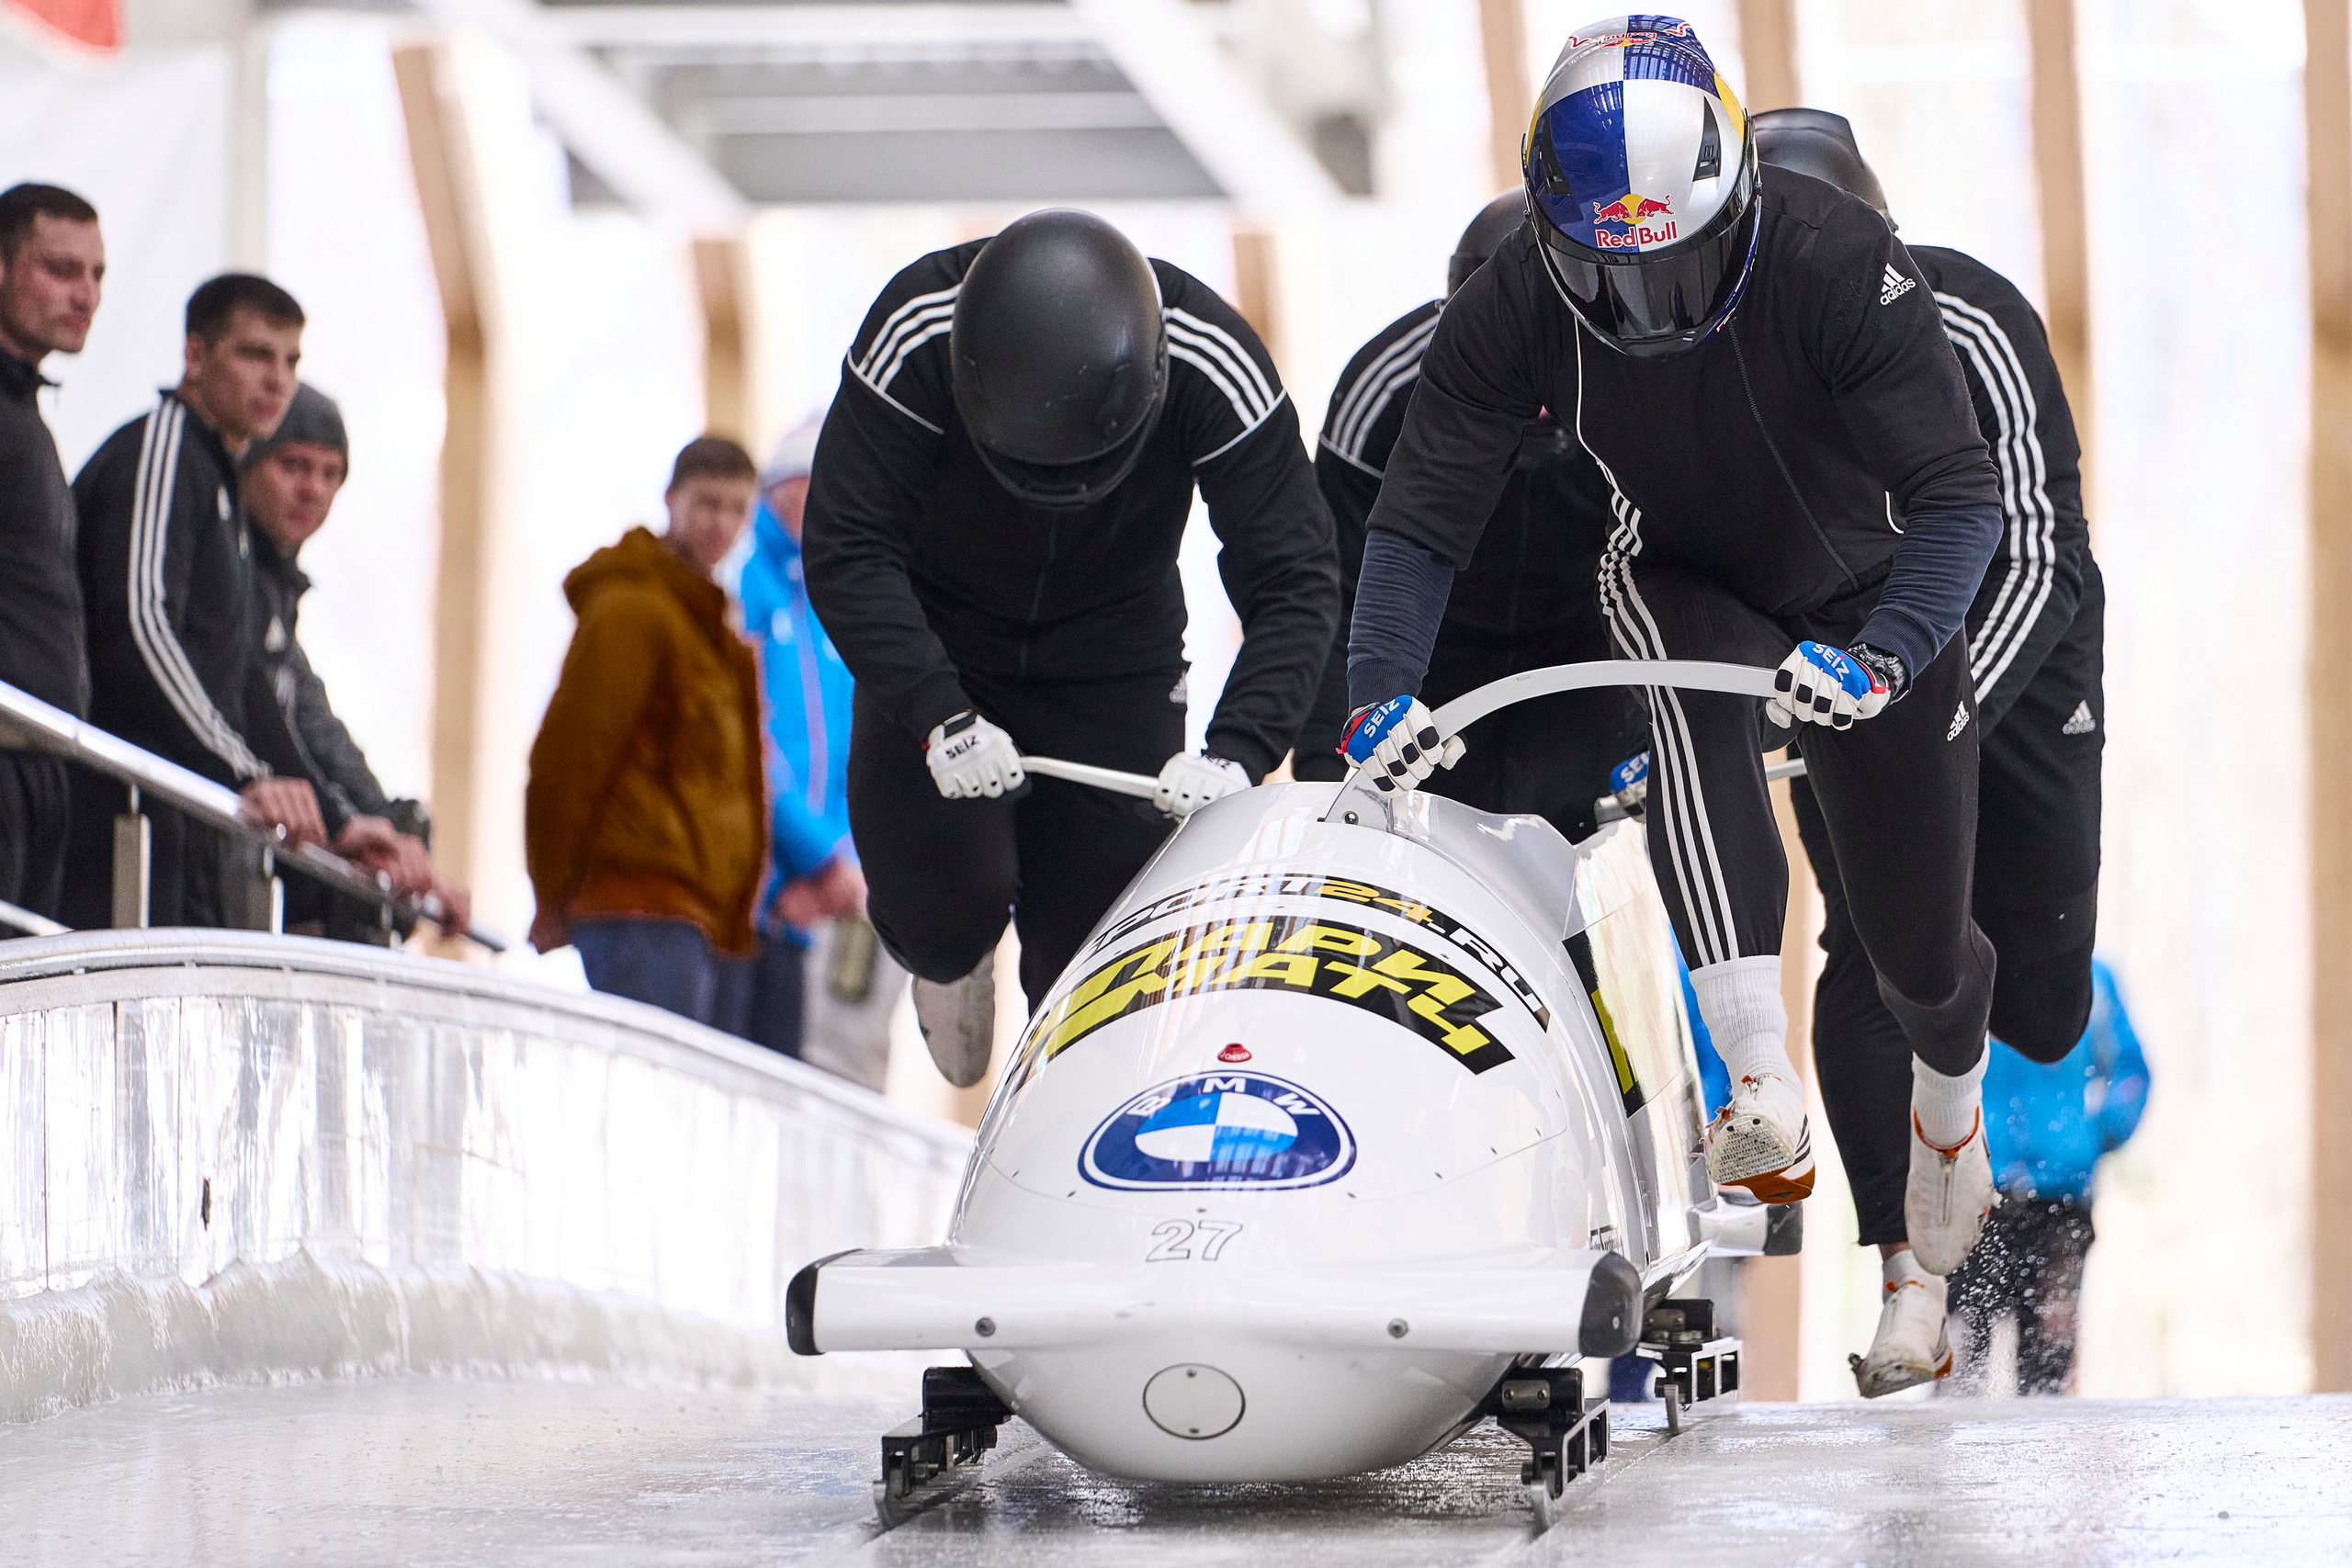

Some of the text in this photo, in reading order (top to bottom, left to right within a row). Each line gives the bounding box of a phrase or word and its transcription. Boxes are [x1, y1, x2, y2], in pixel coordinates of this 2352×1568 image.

[1595, 220, 1678, 248] Red Bull
[1880, 277, 1917, 306] adidas
[1812, 643, 1850, 682] SEIZ
[1363, 698, 1400, 739] SEIZ
[1620, 752, 1648, 783] SEI
[1126, 1077, 1321, 1117] BMW
[1145, 1218, 1243, 1263] 27
